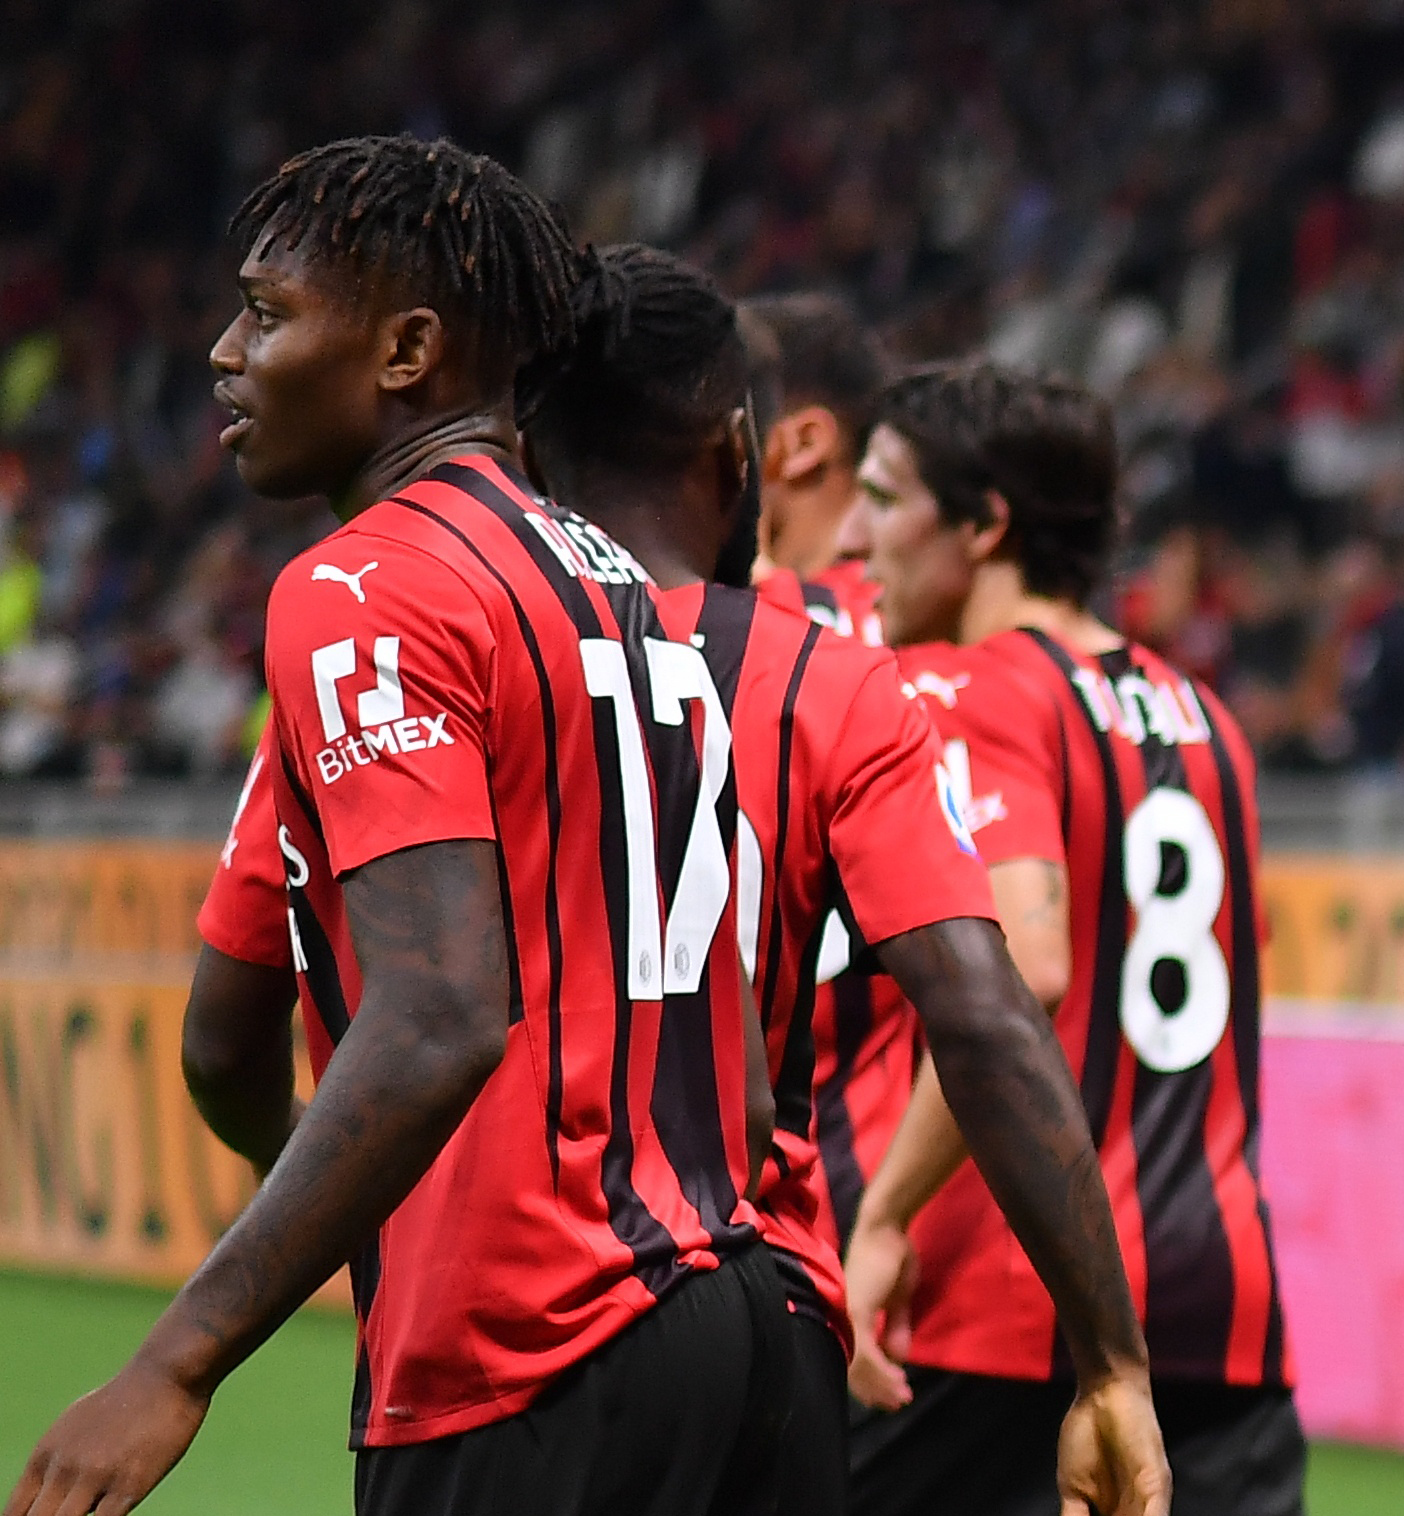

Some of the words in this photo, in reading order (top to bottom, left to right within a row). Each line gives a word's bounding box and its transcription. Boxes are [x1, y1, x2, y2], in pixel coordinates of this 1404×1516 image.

[316, 712, 455, 785] BitMEX
[579, 636, 732, 1000] 17
[1118, 784, 1232, 1073] 8
